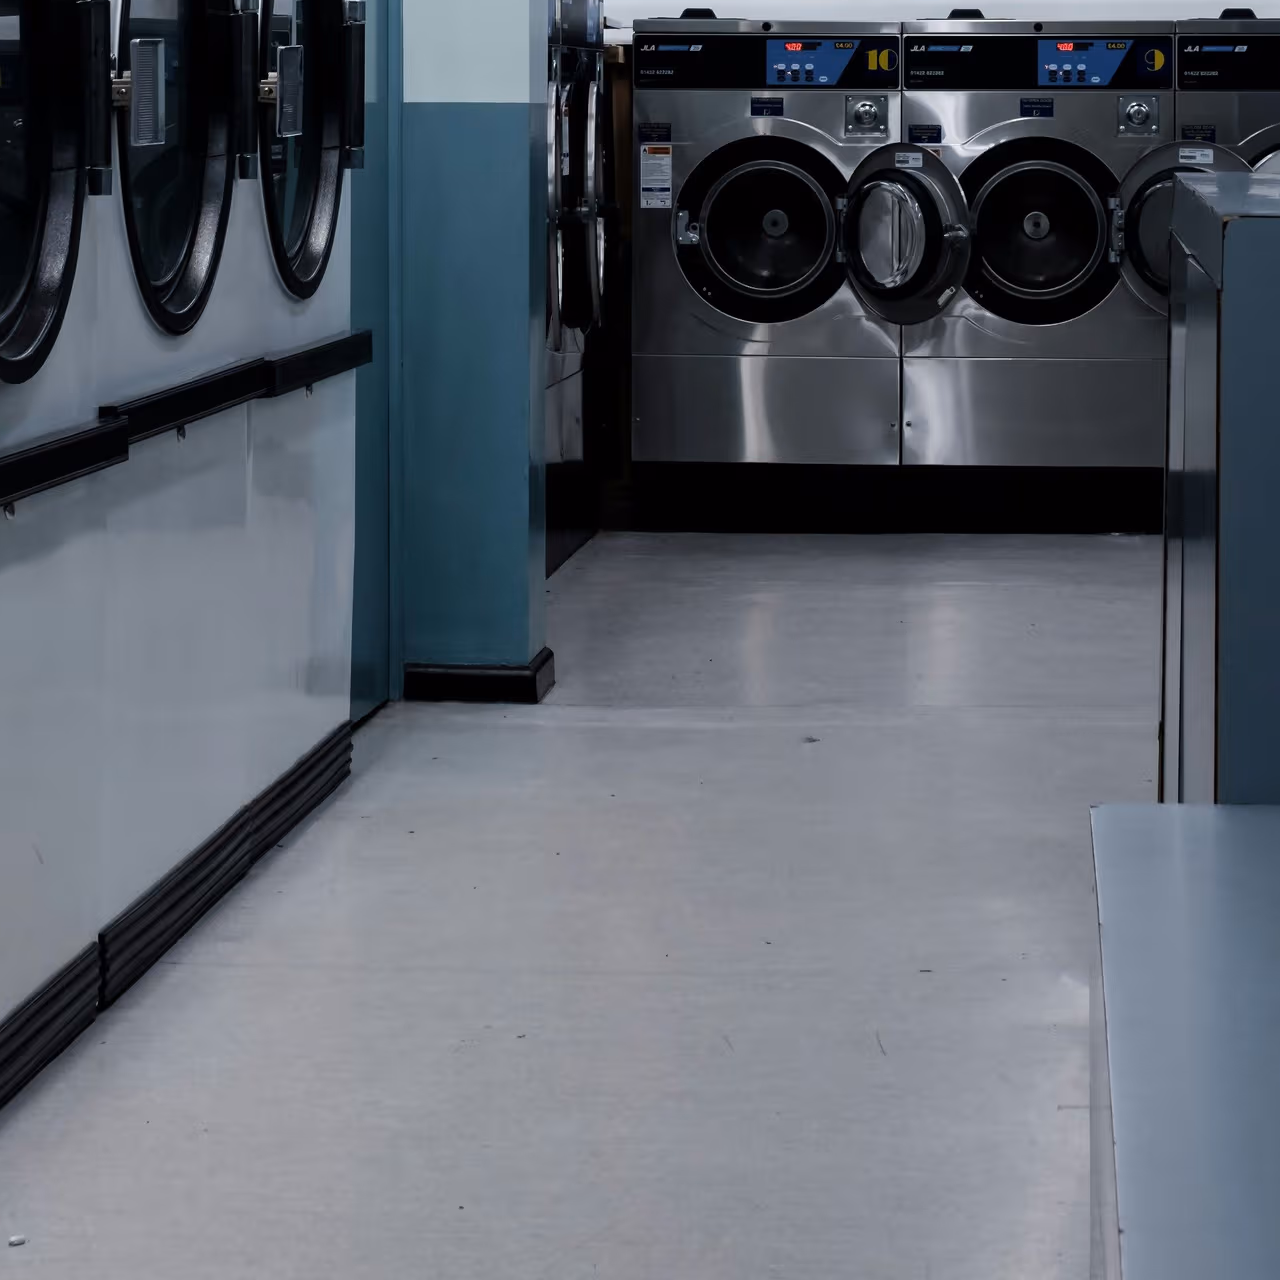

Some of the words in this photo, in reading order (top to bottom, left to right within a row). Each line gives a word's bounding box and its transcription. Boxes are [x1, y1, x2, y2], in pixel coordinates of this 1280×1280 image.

[640, 44, 656, 52] JLA
[865, 48, 898, 71] 10
[1144, 48, 1165, 72] 9
